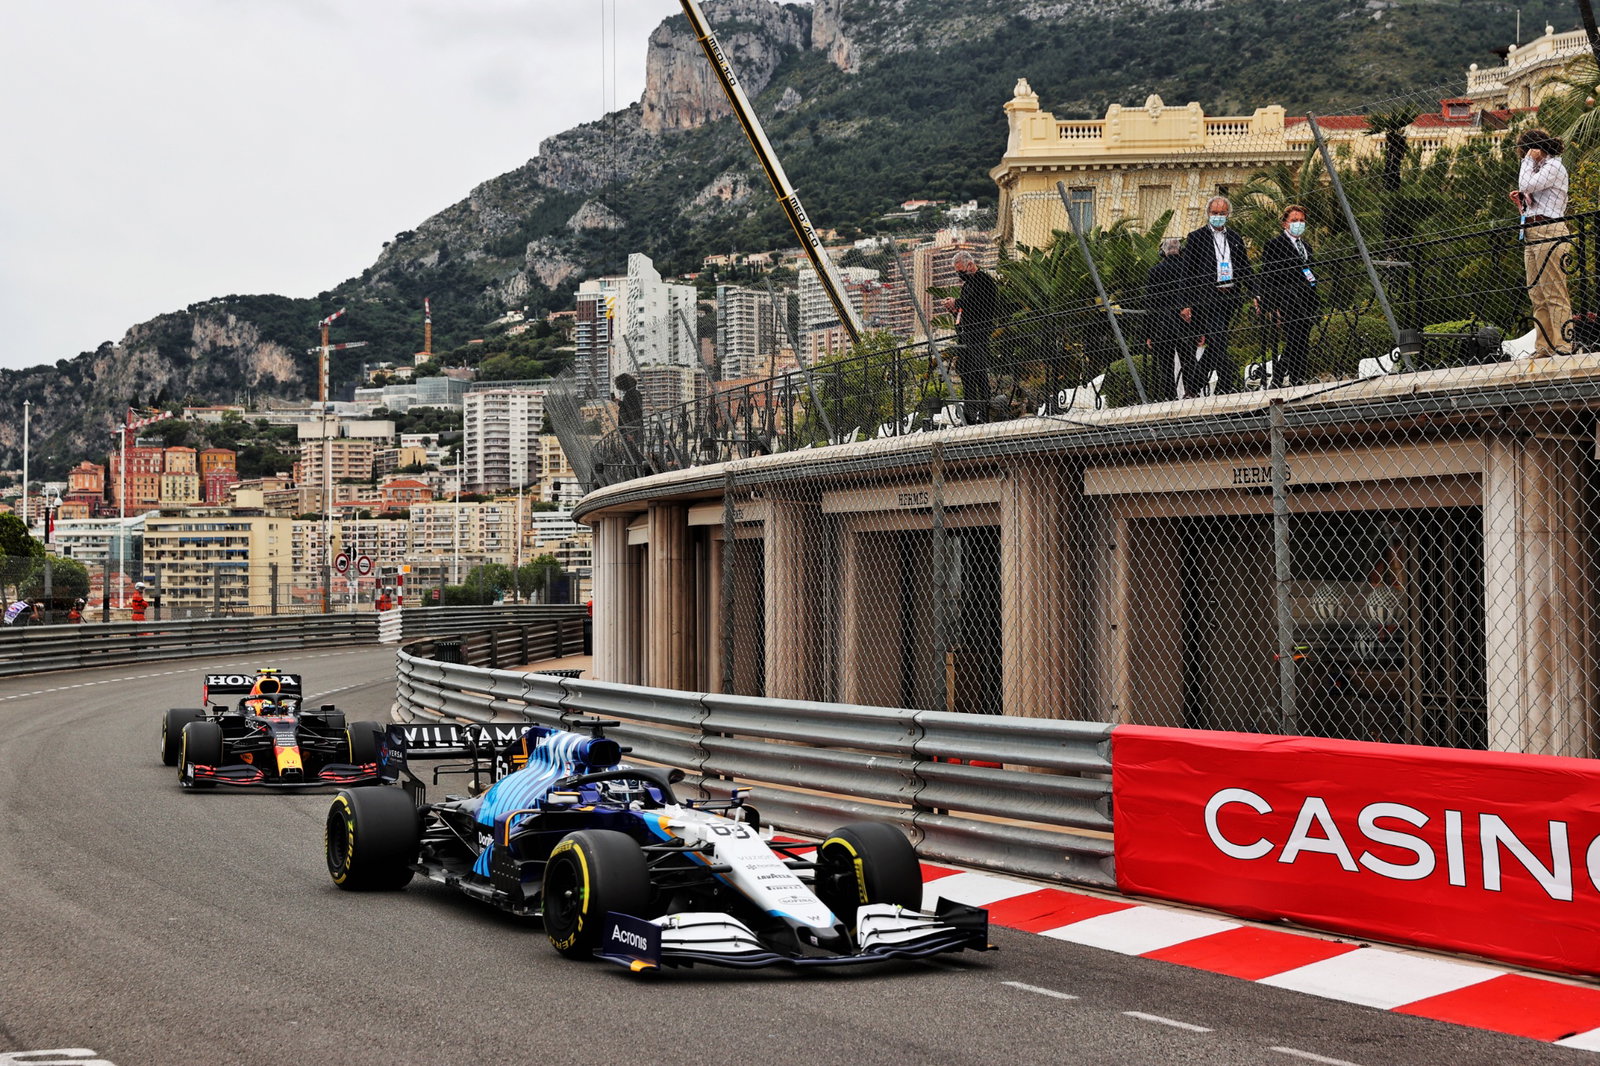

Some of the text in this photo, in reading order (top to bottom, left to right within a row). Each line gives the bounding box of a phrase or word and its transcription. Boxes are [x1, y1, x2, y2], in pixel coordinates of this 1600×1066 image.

[208, 675, 298, 686] HONA
[1203, 787, 1600, 902] CASIN
[611, 924, 648, 951] Acronis
